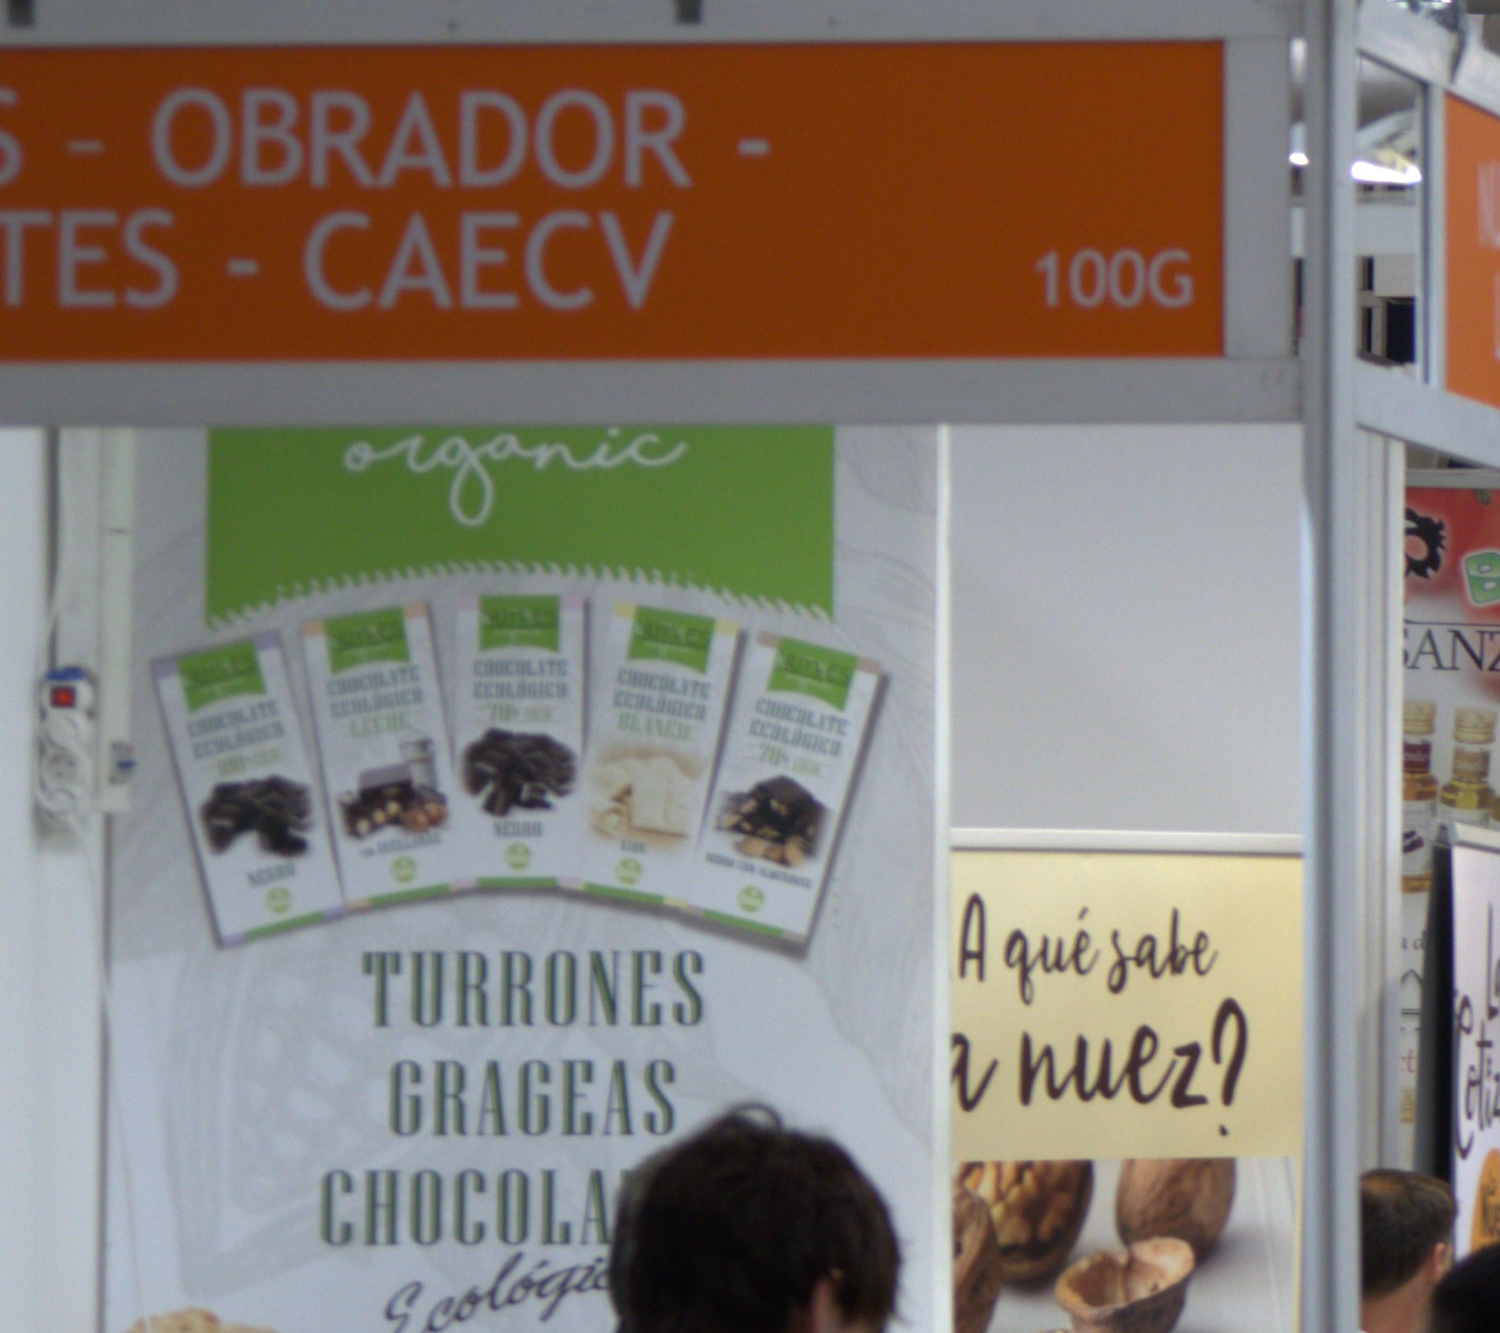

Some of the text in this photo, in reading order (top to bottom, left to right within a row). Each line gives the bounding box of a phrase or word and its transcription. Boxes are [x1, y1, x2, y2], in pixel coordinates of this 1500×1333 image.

[150, 89, 694, 188] OBRADOR
[304, 210, 674, 309] CAECV
[1034, 251, 1194, 309] 100G
[343, 427, 690, 527] organic
[361, 948, 707, 1029] TURRONES
[959, 892, 1219, 1006] A qué sabe
[388, 1059, 677, 1138] GRAGEAS
[950, 996, 1248, 1137] a nuez?
[320, 1168, 622, 1248] CHOCOLA
